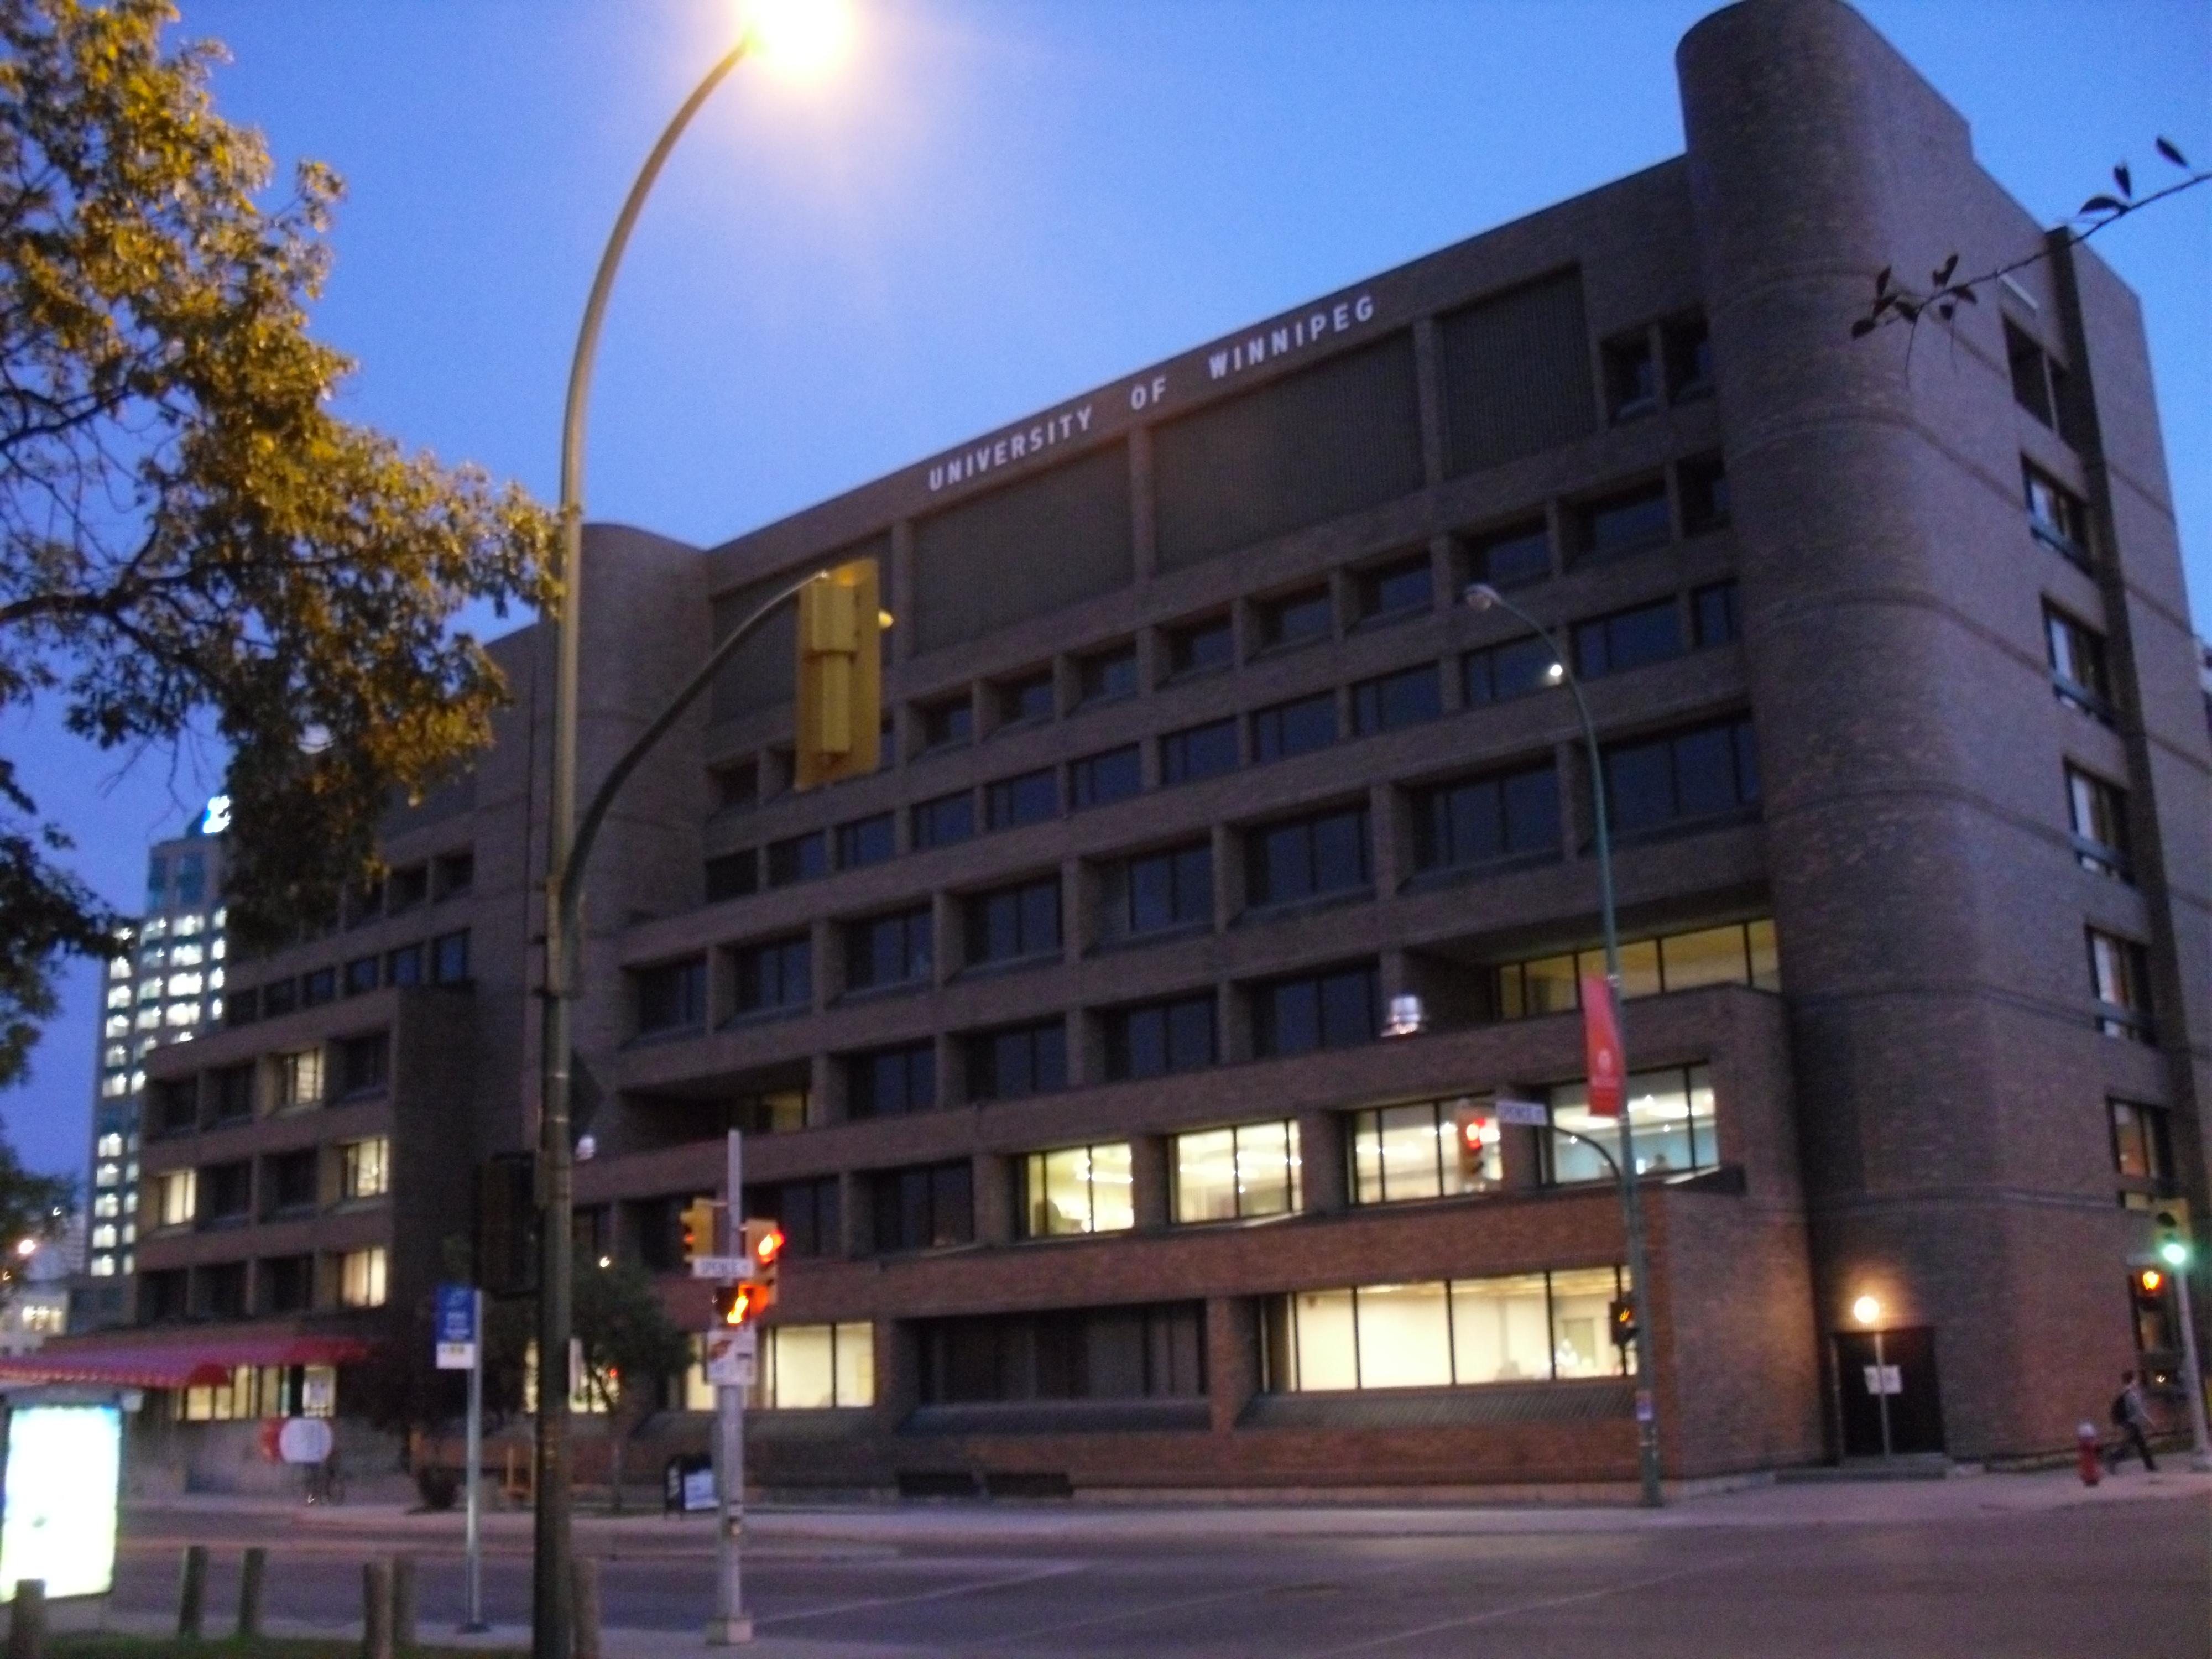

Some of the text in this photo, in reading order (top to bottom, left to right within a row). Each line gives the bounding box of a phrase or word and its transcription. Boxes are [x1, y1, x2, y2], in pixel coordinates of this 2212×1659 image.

[929, 296, 1374, 492] UNIVERSITY OF WINNIPEG
